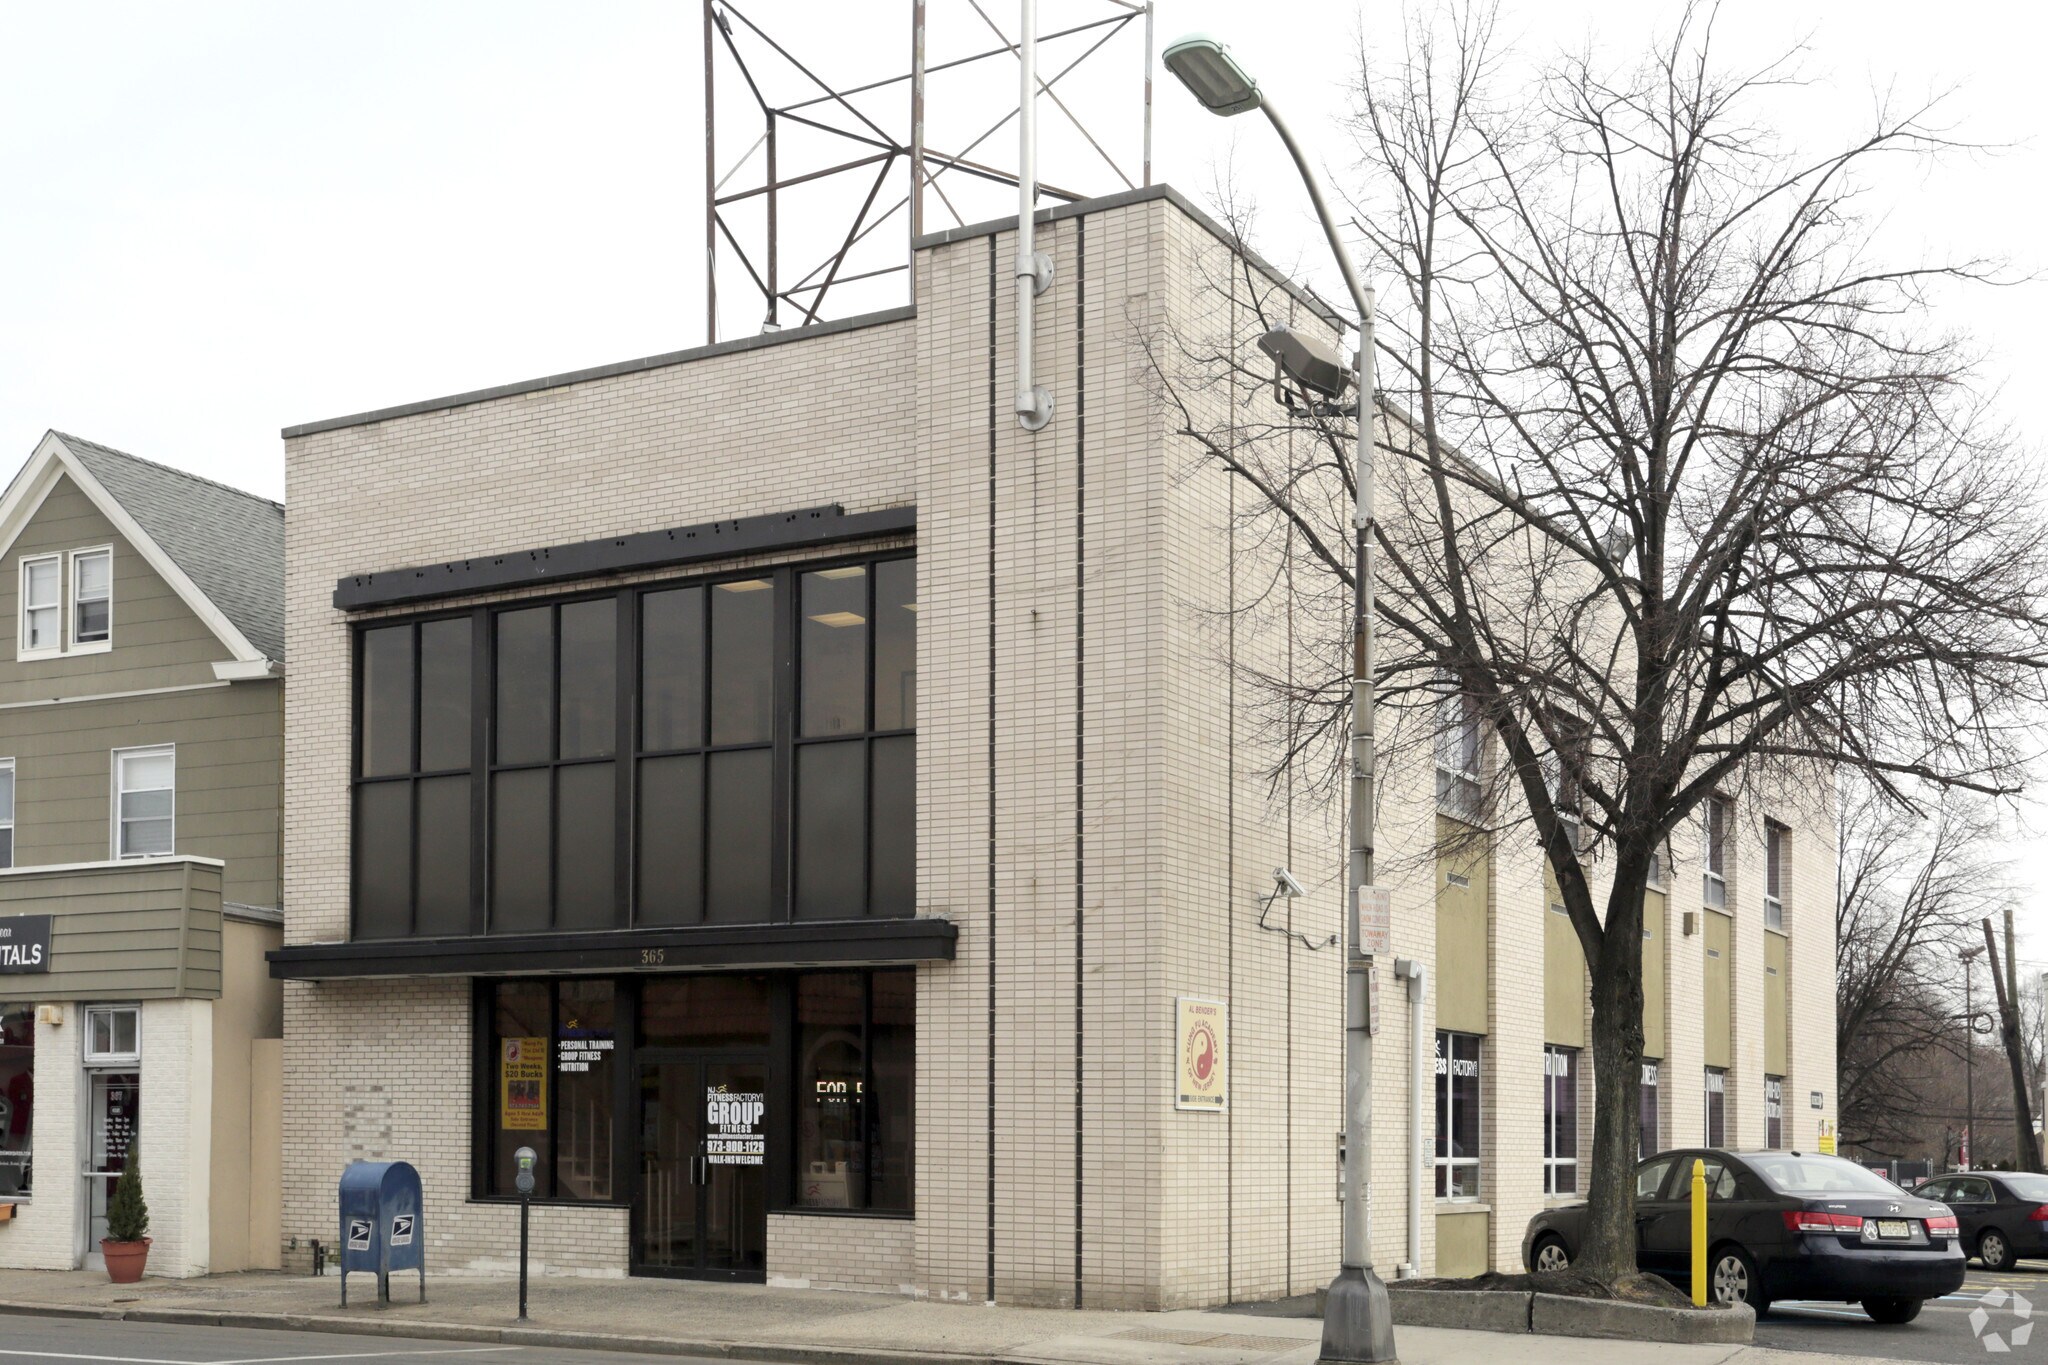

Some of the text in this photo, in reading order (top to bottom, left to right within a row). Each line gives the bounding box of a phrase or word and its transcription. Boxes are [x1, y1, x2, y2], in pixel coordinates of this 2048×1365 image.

[1361, 929, 1389, 939] TOWAWAY
[1366, 939, 1383, 948] ZONE
[0, 943, 42, 966] TALS
[641, 949, 664, 964] 365
[561, 1040, 614, 1050] PERSONAL TRAINING
[561, 1051, 601, 1061] GROUP FITNESS
[561, 1062, 589, 1072] NUTRITION
[505, 1070, 543, 1078] $20 Bucks
[707, 1086, 716, 1094] NJ
[707, 1101, 764, 1125] GROUP
[720, 1124, 752, 1134] FITNESS
[707, 1140, 764, 1153] 973-900-1129
[708, 1154, 763, 1165] WALK-INS WELCOME
